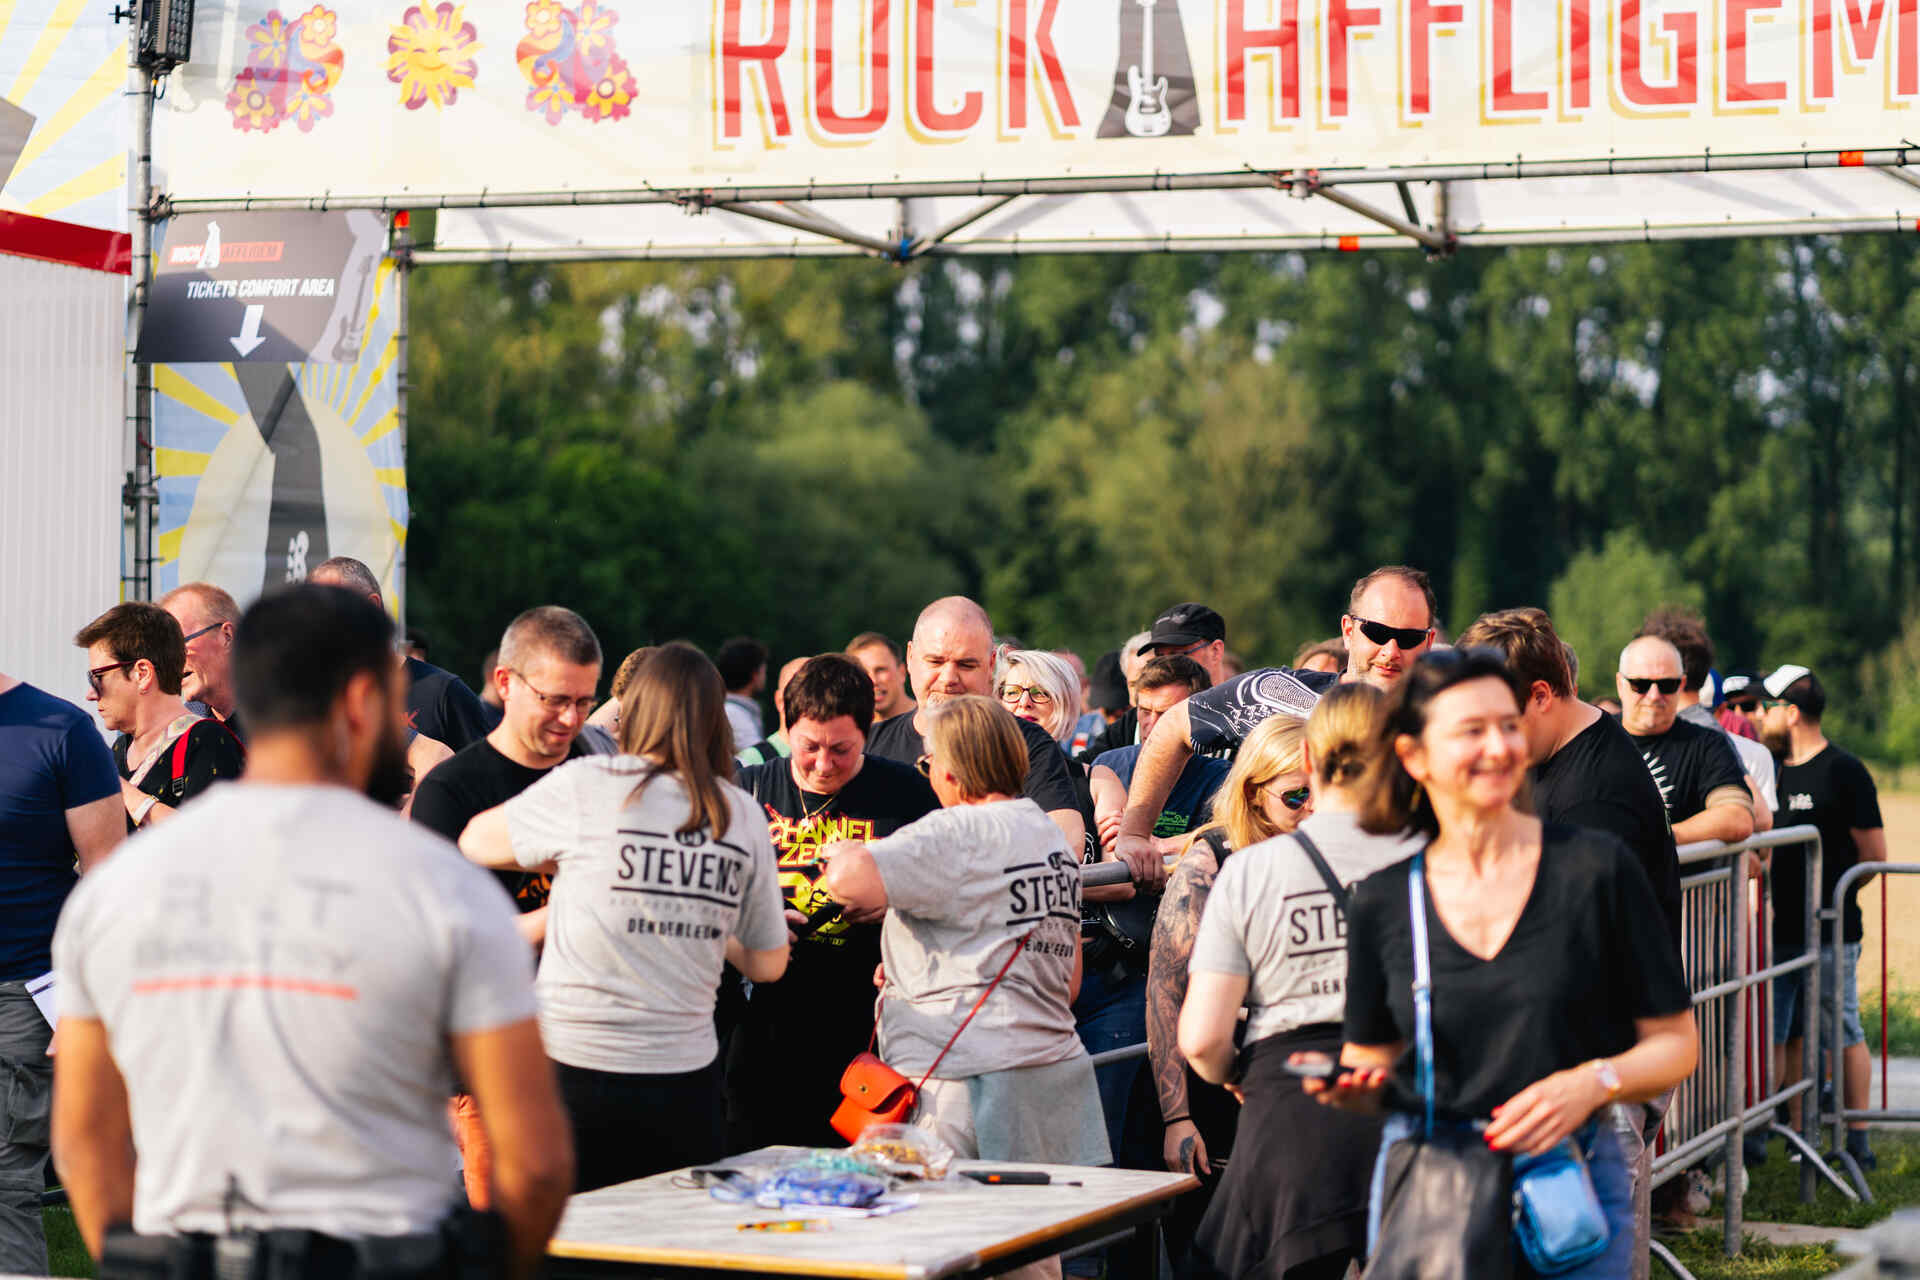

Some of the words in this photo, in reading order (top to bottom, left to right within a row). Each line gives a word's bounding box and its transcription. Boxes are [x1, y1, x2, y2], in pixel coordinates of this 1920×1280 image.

[714, 0, 1081, 149] ROCK
[187, 280, 238, 299] TICKETS
[238, 279, 300, 297] COMFORT
[300, 278, 335, 296] AREA
[767, 810, 883, 846] CHANNEL
[617, 844, 743, 897] STEVENS
[778, 842, 828, 866] ZE
